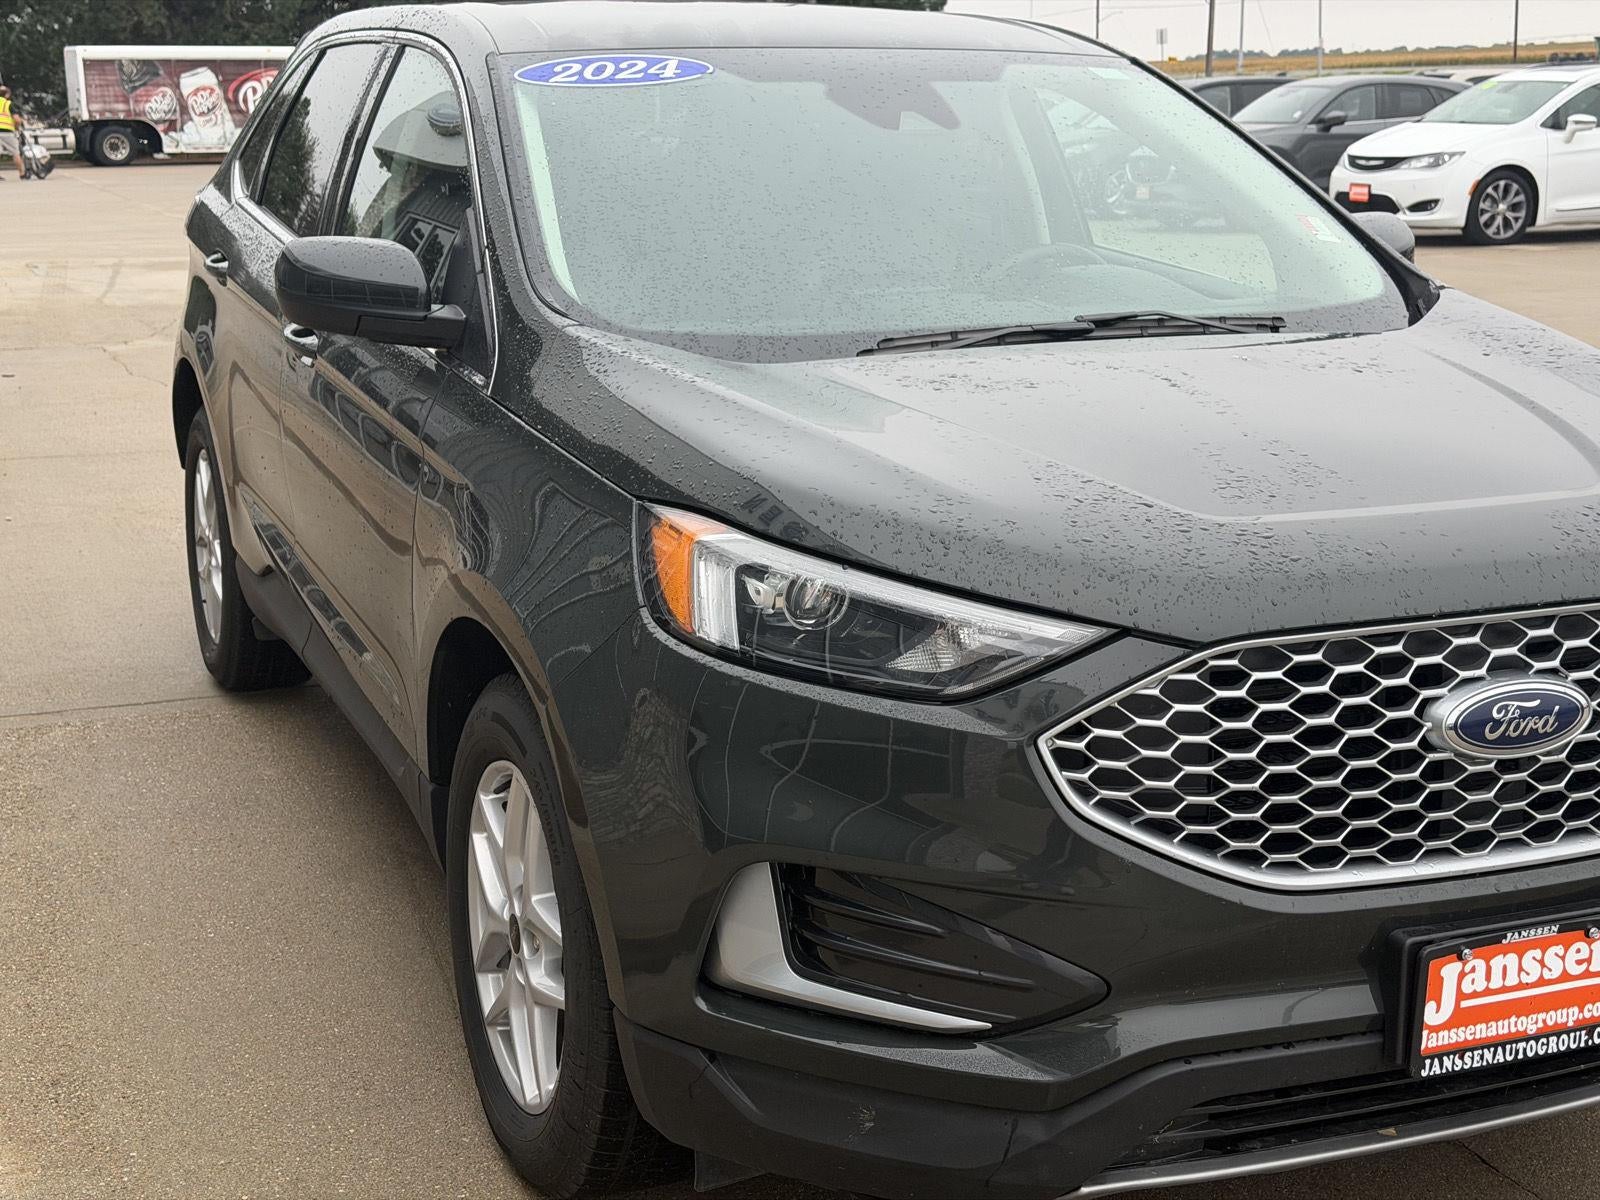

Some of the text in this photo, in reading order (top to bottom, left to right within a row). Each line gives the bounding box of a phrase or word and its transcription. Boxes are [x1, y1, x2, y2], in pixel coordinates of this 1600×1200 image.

[549, 60, 681, 83] 2024
[1484, 699, 1560, 741] Ford
[1501, 924, 1560, 944] JANSSEN
